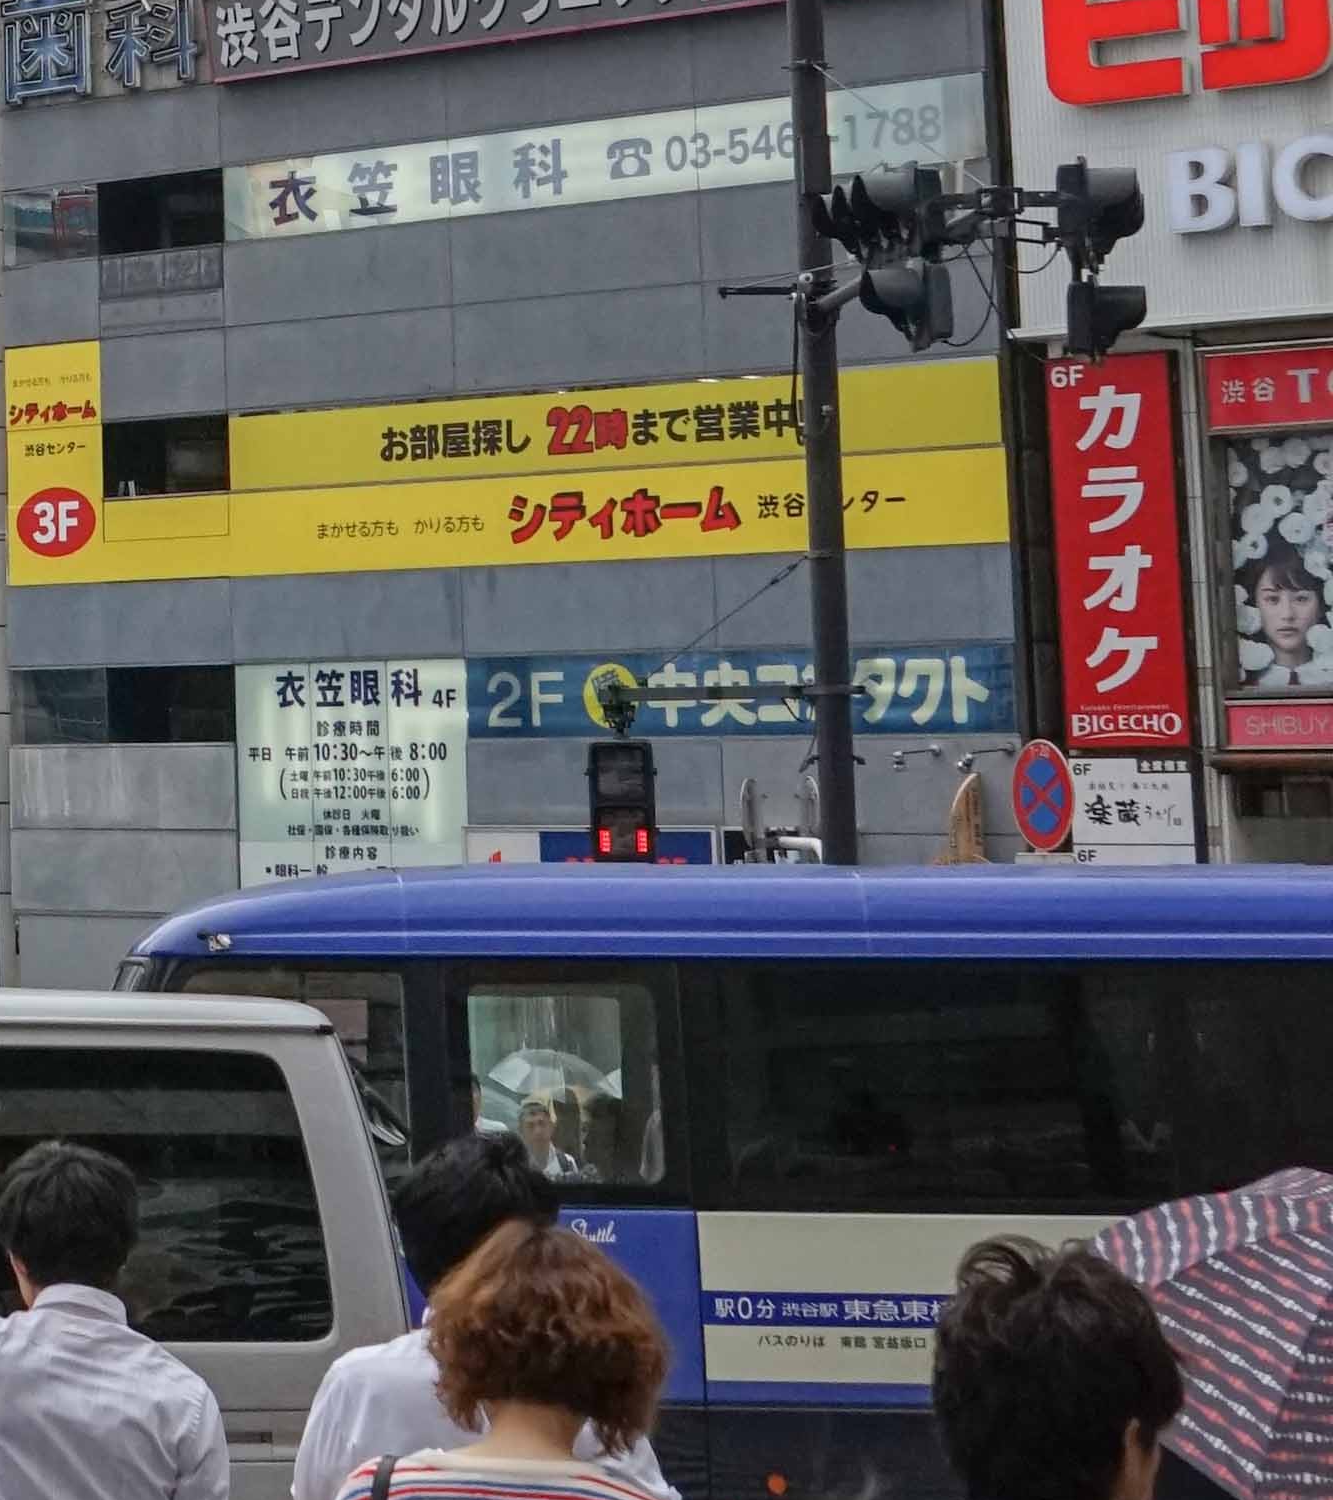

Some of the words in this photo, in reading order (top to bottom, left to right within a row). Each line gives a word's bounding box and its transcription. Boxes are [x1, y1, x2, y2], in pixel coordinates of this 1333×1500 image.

[665, 103, 942, 171] 03-546-1788
[1049, 364, 1086, 389] 6F
[1220, 376, 1276, 405] 渋谷
[1286, 367, 1333, 404] T
[8, 400, 97, 426] シティホーム
[24, 442, 86, 458] 渋谷センター
[379, 414, 531, 463] お部屋探し
[32, 500, 80, 545] 3F
[316, 515, 399, 540] まかせる方も
[413, 513, 485, 535] かりる方も
[508, 486, 742, 546] シティホーム
[756, 490, 907, 521] 渋谷ター
[1076, 384, 1159, 694] カラオケ
[275, 668, 422, 709] 衣笠眼科
[432, 688, 457, 709] 4F
[486, 671, 565, 729] 2F
[647, 656, 990, 728] 中央コタクト
[316, 720, 380, 738] 診療時間
[1071, 713, 1114, 738] BIG
[1118, 711, 1183, 737] ECHO
[248, 746, 272, 762] 平日
[285, 746, 309, 762] 午前
[409, 742, 448, 761] 8:00
[391, 767, 420, 782] 6:00
[1073, 764, 1093, 777] 6F
[391, 786, 421, 800] 6:00
[1077, 850, 1097, 863] 6F
[714, 1296, 776, 1321] 駅0分
